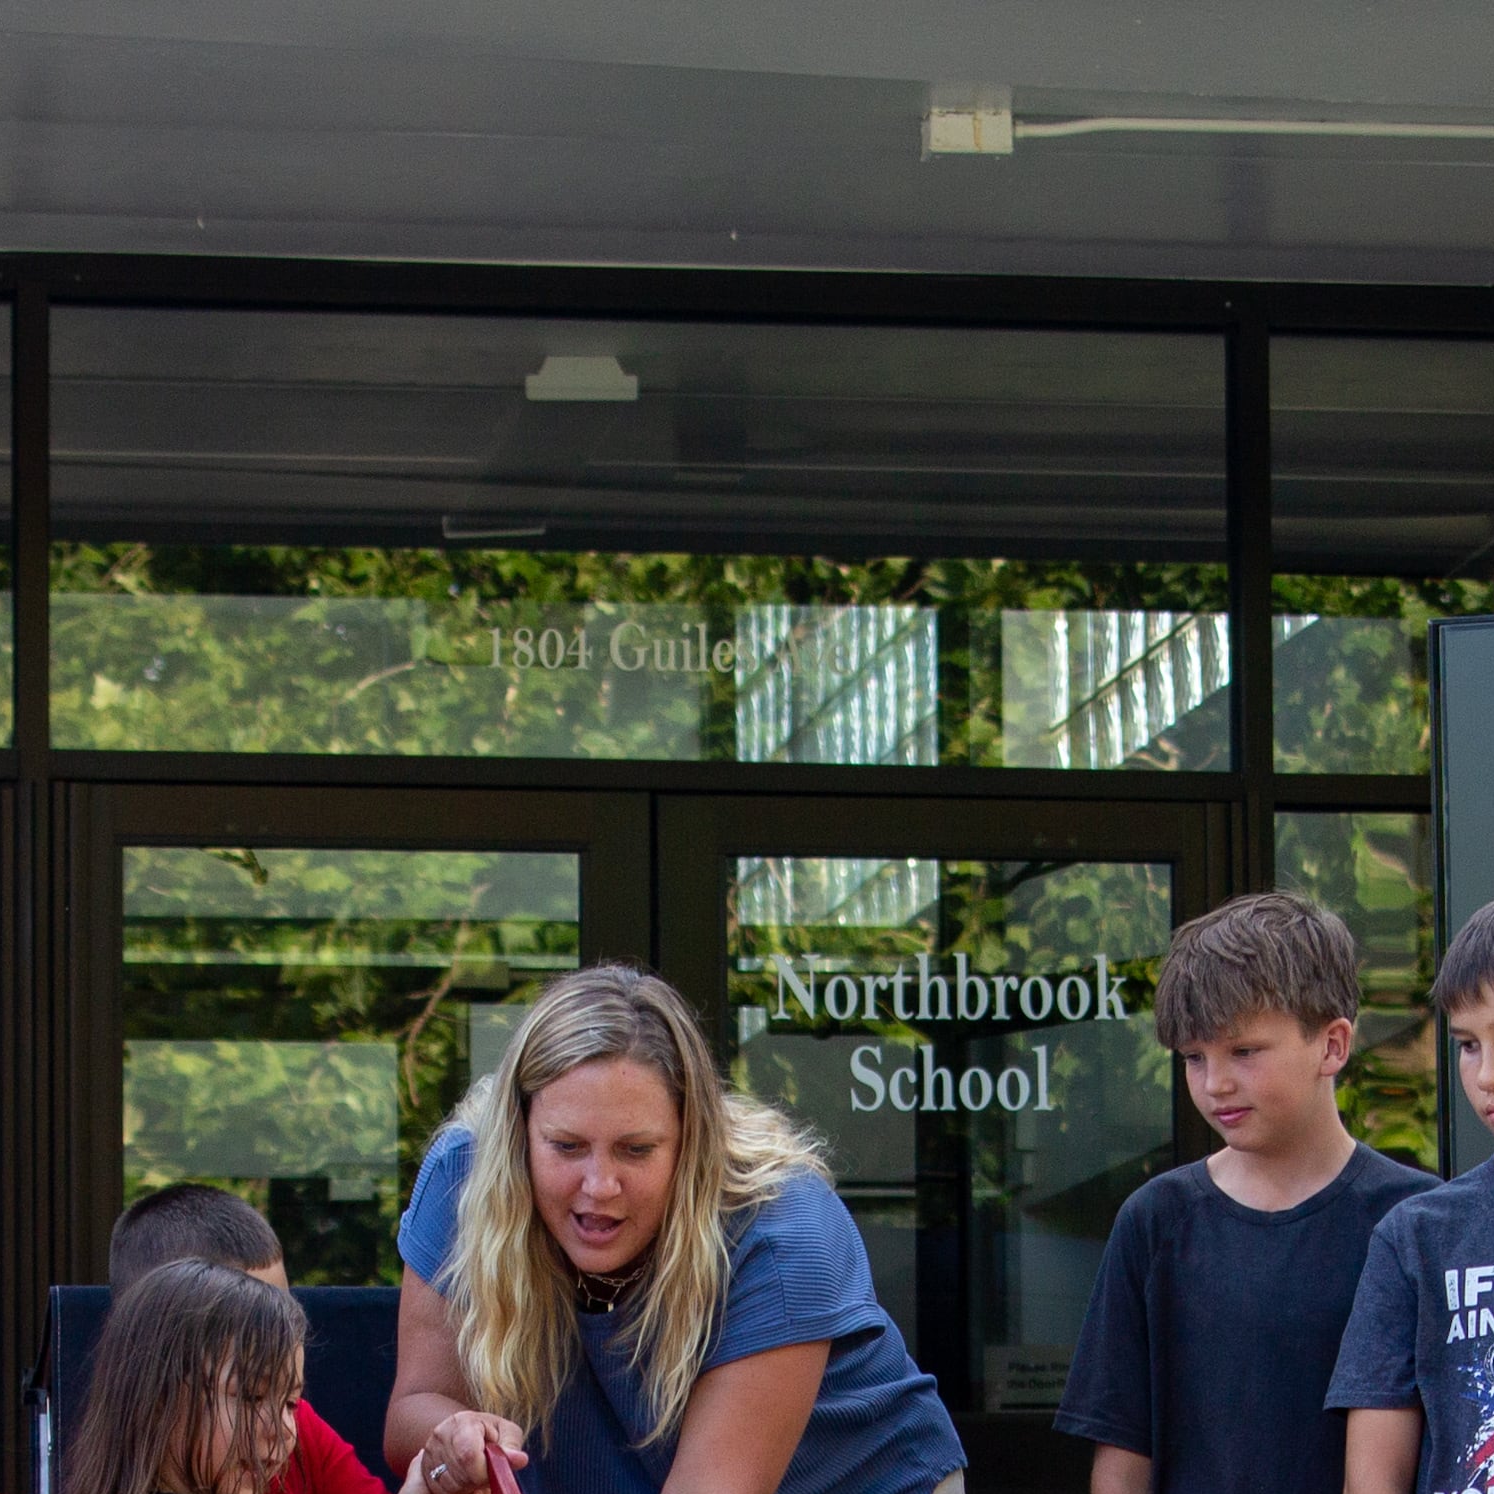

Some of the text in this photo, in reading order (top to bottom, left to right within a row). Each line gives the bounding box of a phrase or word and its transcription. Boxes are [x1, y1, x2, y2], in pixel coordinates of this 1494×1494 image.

[489, 626, 593, 671] 1804
[610, 621, 759, 674] Guiles
[769, 952, 1131, 1021] Northbrook
[849, 1043, 1054, 1112] School
